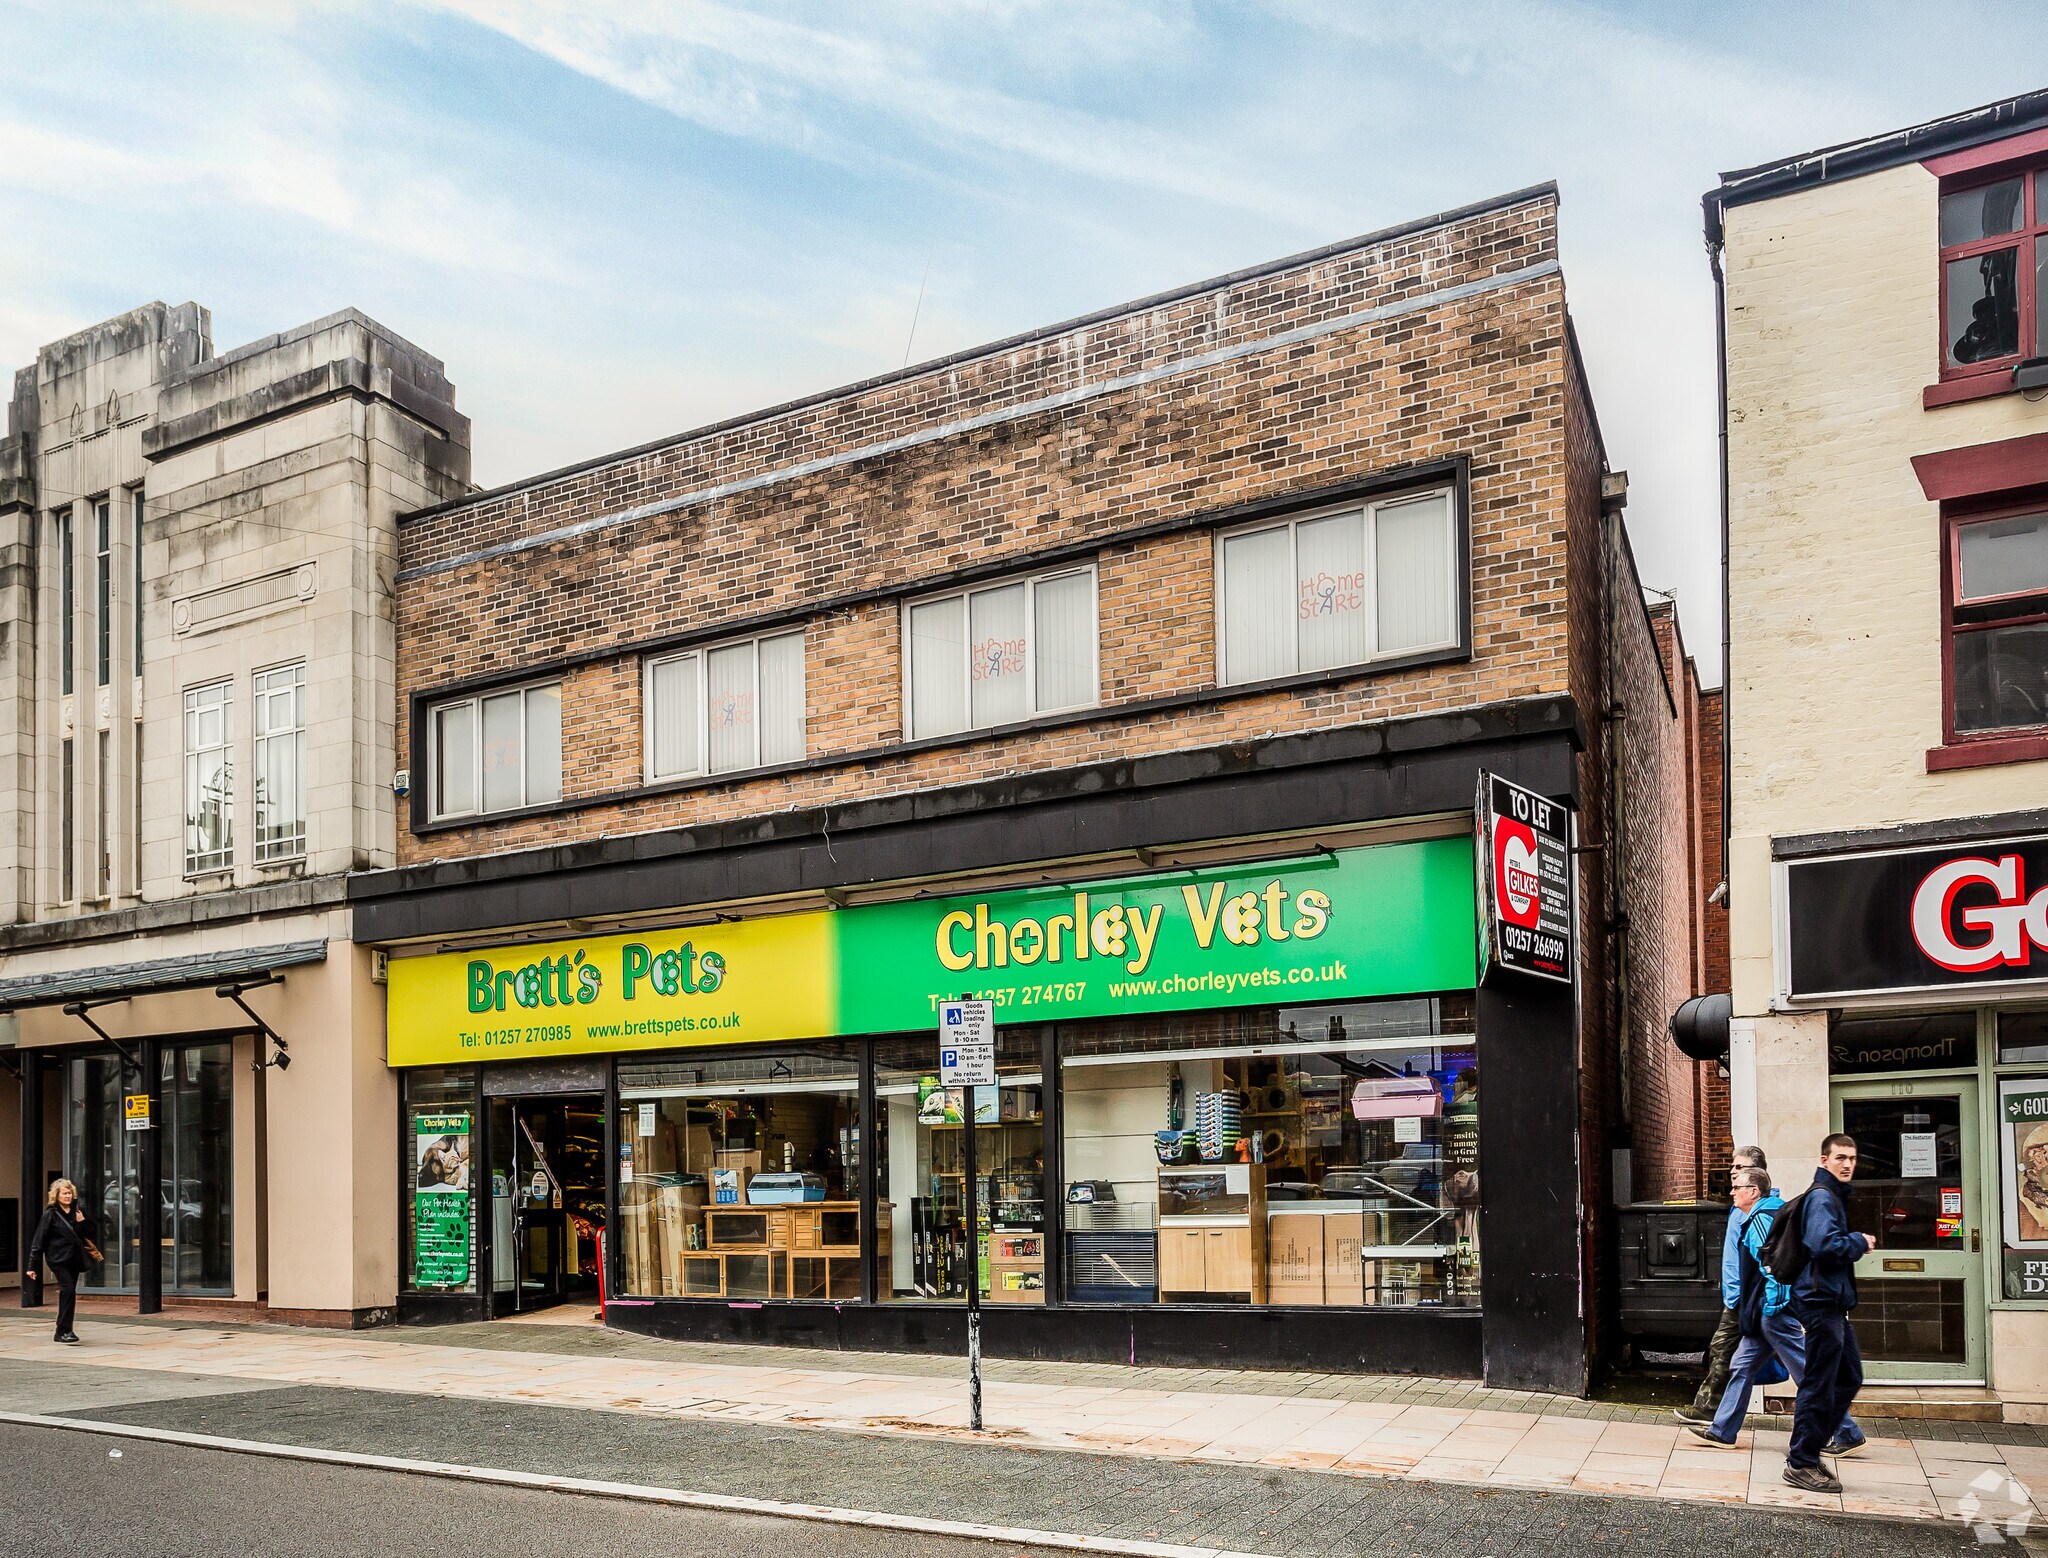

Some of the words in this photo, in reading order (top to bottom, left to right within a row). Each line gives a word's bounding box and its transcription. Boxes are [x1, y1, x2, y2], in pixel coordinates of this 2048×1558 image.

[1509, 788, 1529, 821] TO
[1531, 798, 1551, 831] LET
[1510, 871, 1538, 898] GILKES
[935, 892, 1164, 975] Chorley
[1181, 879, 1335, 950] Vets
[1506, 926, 1532, 952] 01257
[1533, 934, 1564, 961] 266999
[466, 948, 603, 1016] Brett's
[622, 940, 728, 1001] Pets
[963, 988, 1016, 1007] 1257
[1021, 982, 1087, 1006] 274767
[1108, 960, 1347, 998] www.chorleyvets.co.uk
[459, 1032, 481, 1048] Tel:
[485, 1028, 521, 1047] 01257
[526, 1024, 572, 1044] 270985
[587, 1011, 741, 1039] www.brettspets.co.uk
[946, 1053, 955, 1066] P
[1891, 1083, 1914, 1095] 110
[424, 1118, 446, 1128] Chorley
[448, 1118, 461, 1127] Vets
[422, 1199, 432, 1207] Our
[433, 1198, 442, 1207] Pet
[443, 1199, 461, 1207] Health
[423, 1209, 436, 1217] Plan
[438, 1210, 460, 1218] includes
[2024, 1277, 2048, 1292] D
